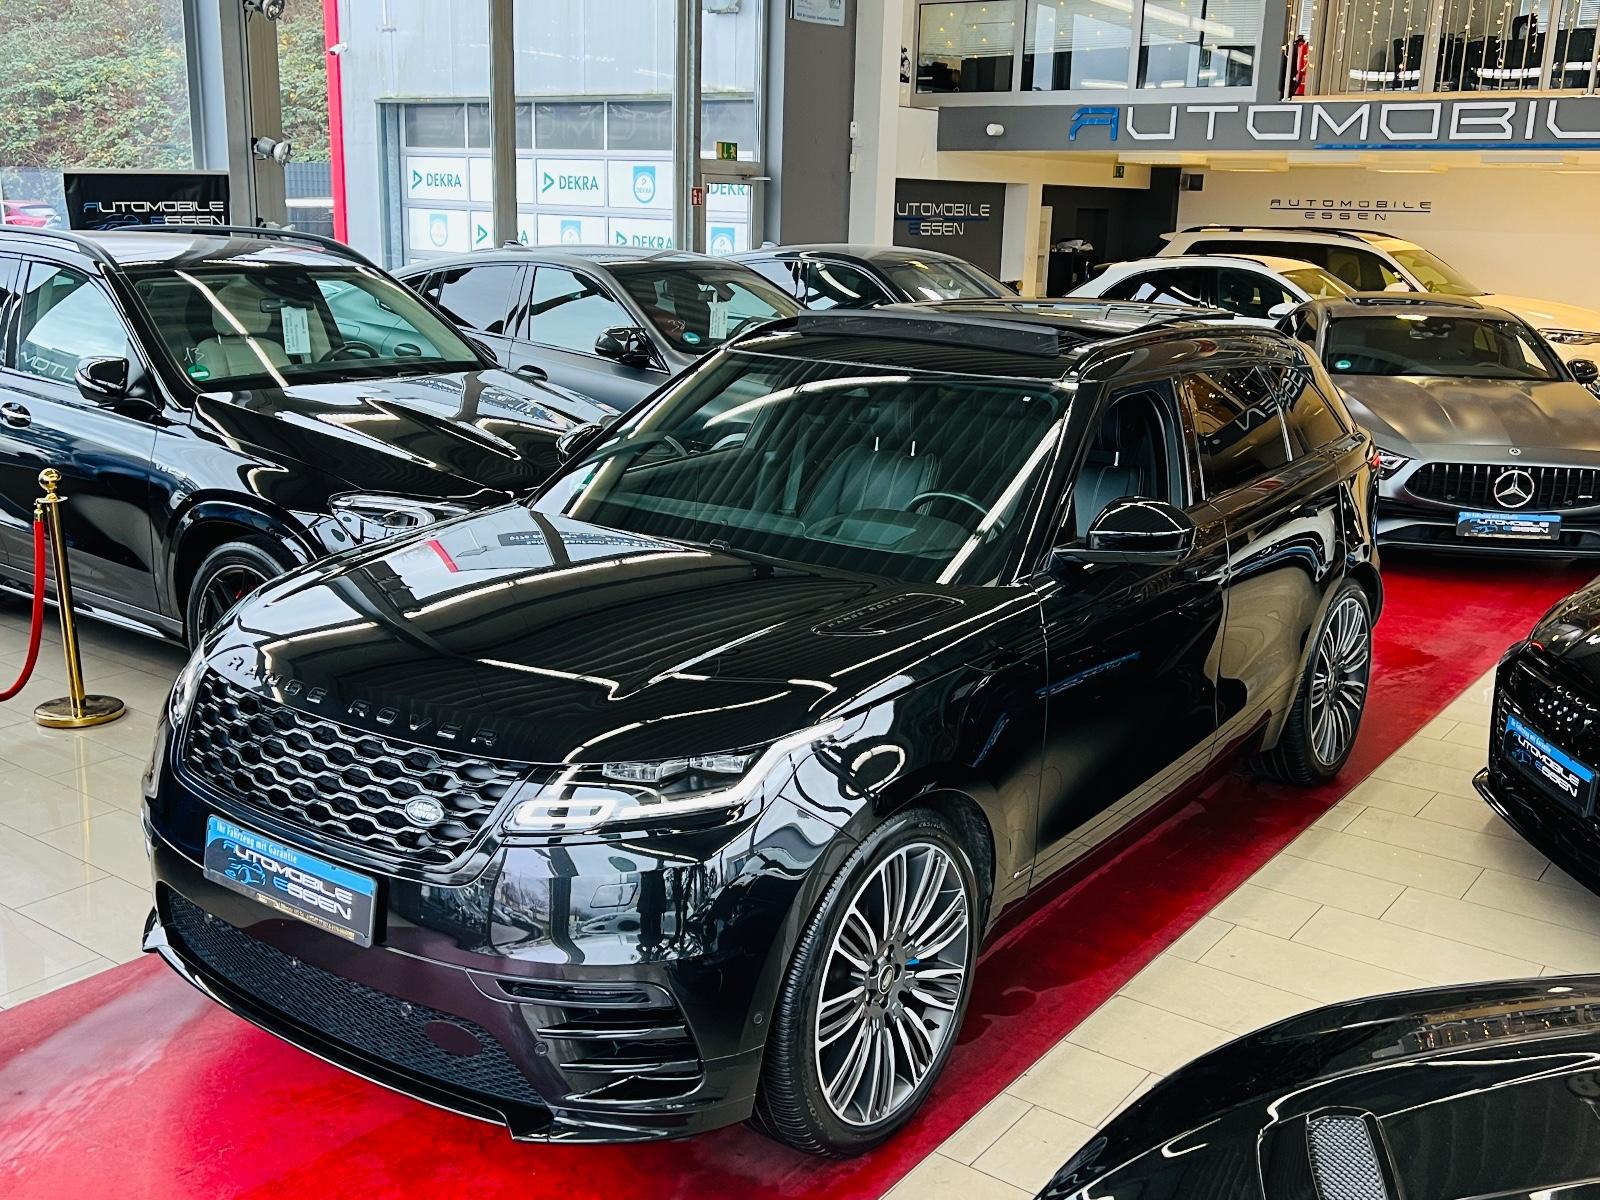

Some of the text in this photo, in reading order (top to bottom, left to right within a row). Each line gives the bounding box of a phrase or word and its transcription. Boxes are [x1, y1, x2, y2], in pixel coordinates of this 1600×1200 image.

[1069, 100, 1600, 141] AUTOMOBIL
[426, 173, 462, 187] DEKRA
[559, 175, 599, 190] DEKRA
[710, 183, 748, 196] DEKR
[83, 201, 224, 213] AUTOMOBILE
[896, 202, 991, 217] UTOMOBILE
[1270, 199, 1432, 209] AUTOMOBILE
[150, 215, 225, 226] ESSEN
[1304, 211, 1387, 221] ESSEN
[908, 222, 964, 236] ESSEN
[227, 656, 498, 747] RANGE ROVER
[1512, 731, 1580, 787] AUTOMOBILE
[1534, 760, 1578, 797] ESSEN
[223, 839, 353, 905] AUTOMOBILE
[273, 875, 352, 920] ESSEN
